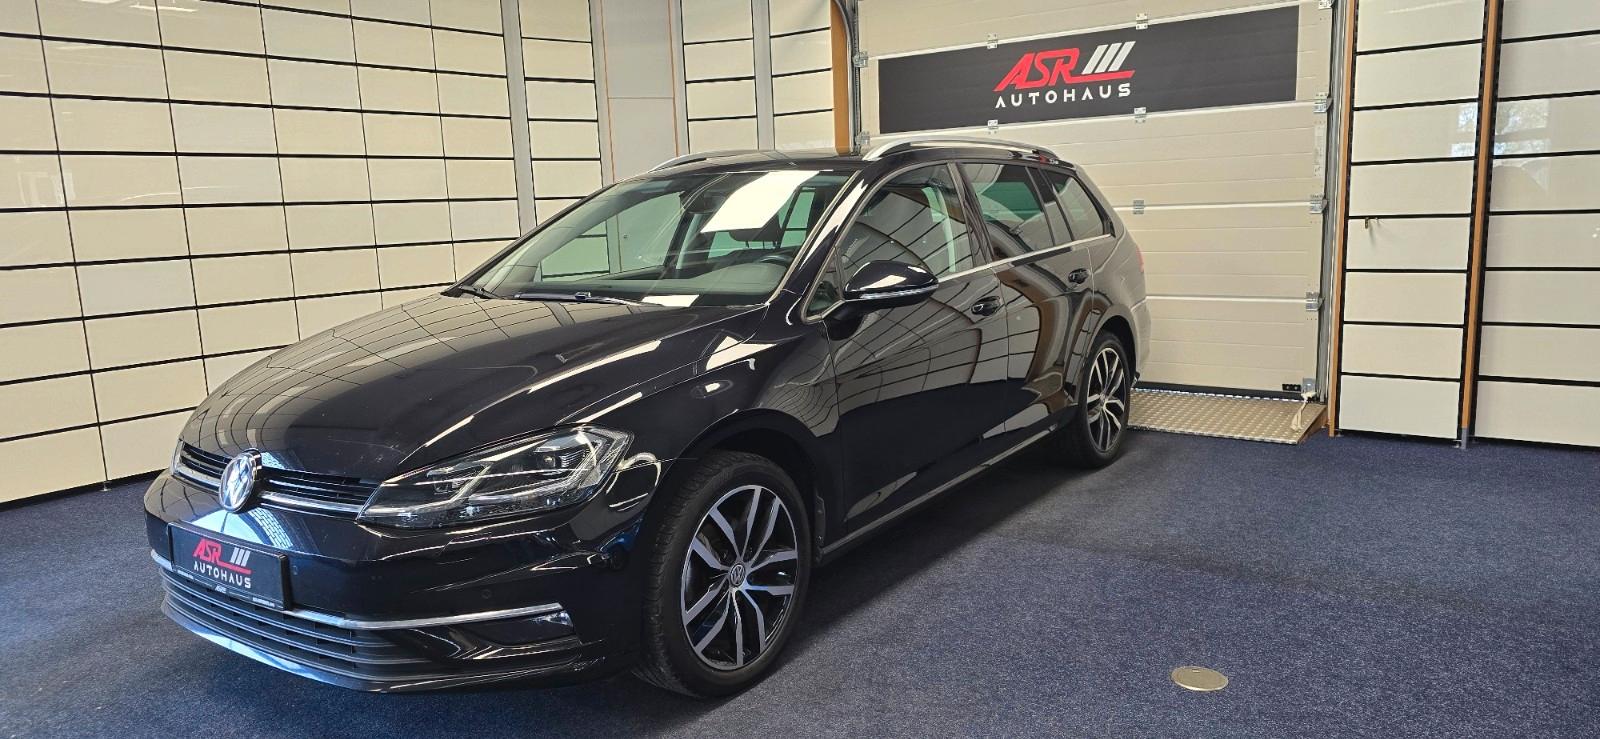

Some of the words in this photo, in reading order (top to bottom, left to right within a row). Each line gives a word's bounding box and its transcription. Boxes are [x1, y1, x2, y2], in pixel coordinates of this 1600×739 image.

[993, 48, 1135, 92] ASR
[995, 83, 1131, 109] AUTOHAUS
[193, 538, 252, 575] ASR
[193, 560, 252, 589] AUTOHAUS
